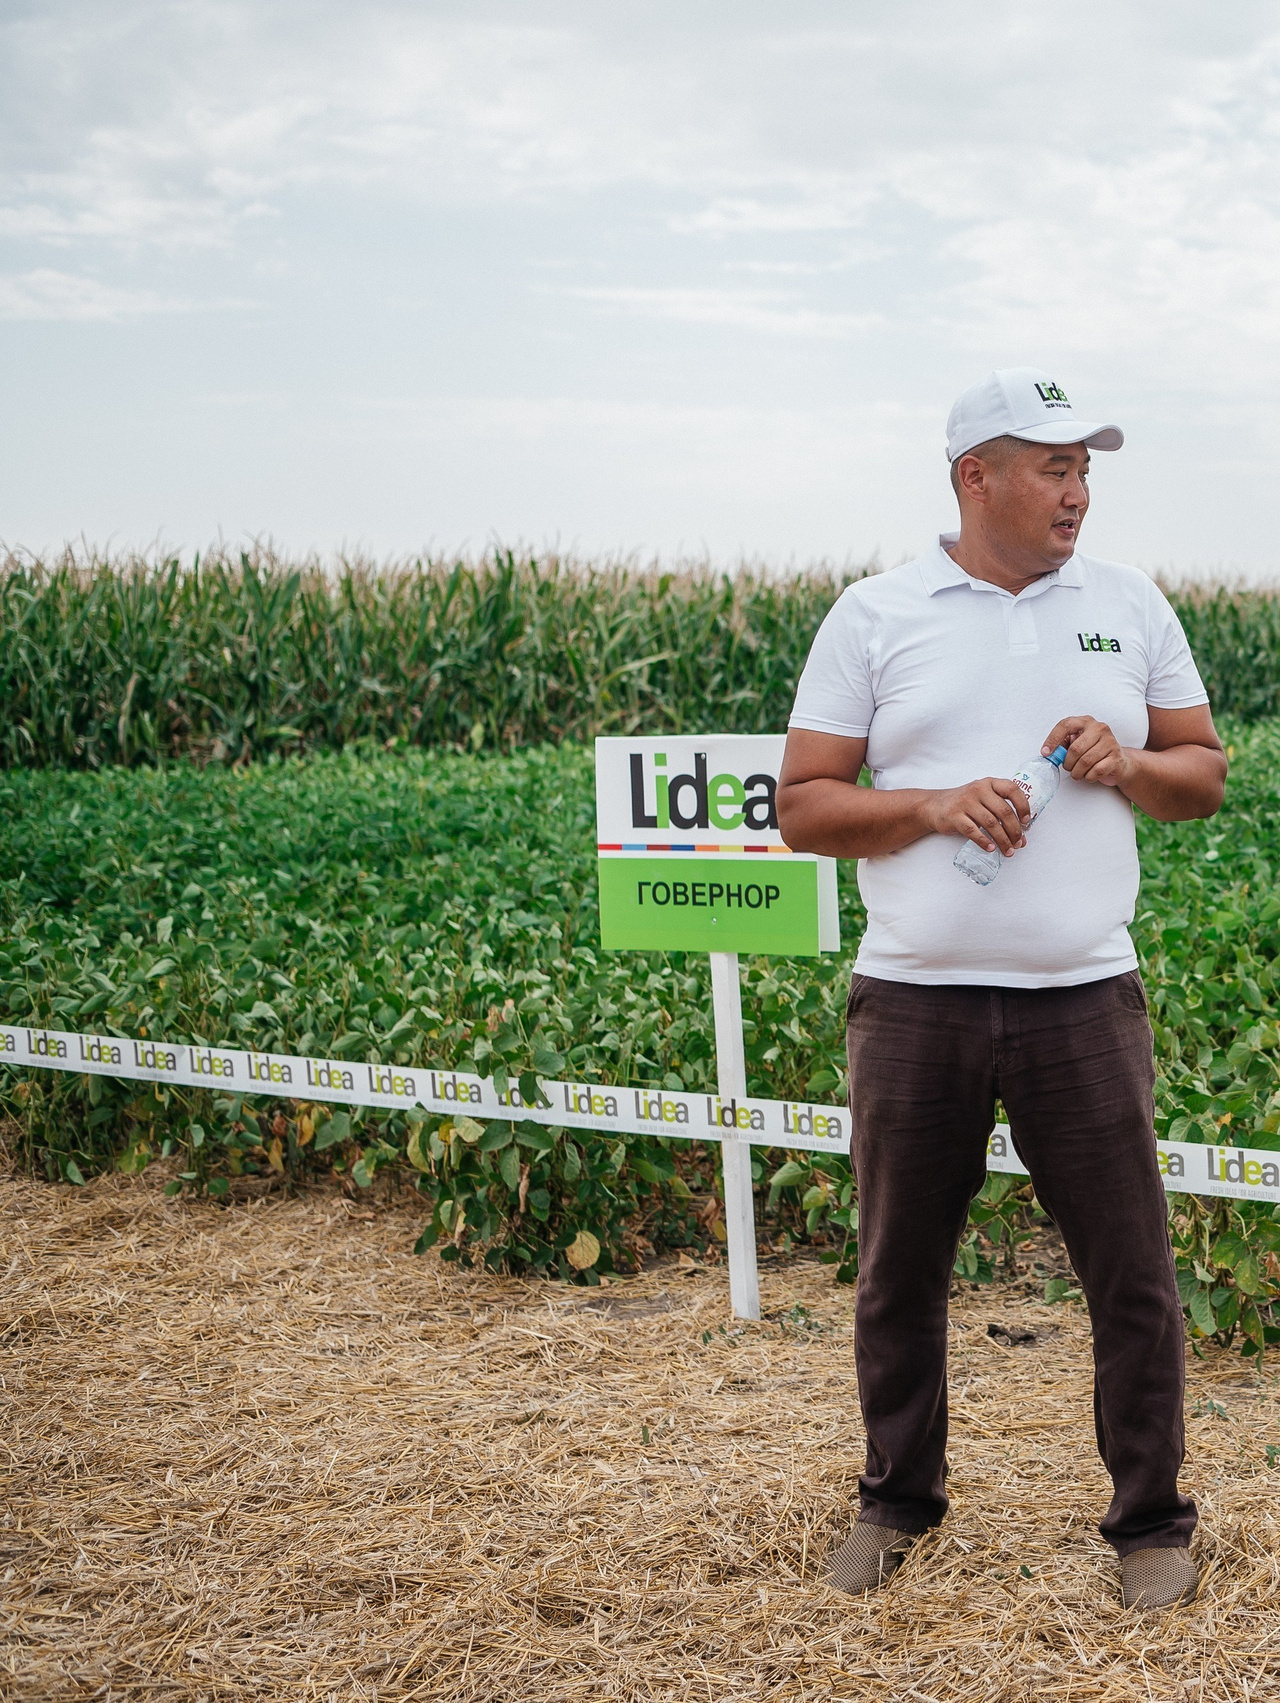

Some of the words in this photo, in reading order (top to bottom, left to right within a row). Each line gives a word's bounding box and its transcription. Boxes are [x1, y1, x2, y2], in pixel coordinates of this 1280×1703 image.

[1077, 633, 1122, 652] Lidea
[629, 752, 780, 830] Lidea
[637, 881, 780, 909] ГОВЕРНОР
[27, 1029, 67, 1058] Lidea
[79, 1035, 121, 1065] Lidea
[133, 1041, 177, 1071] Lidea
[189, 1047, 234, 1077] Lidea
[247, 1053, 293, 1084] Lidea
[306, 1059, 354, 1090] Lidea
[368, 1066, 416, 1097] Lidea
[430, 1072, 482, 1104] Lidea
[564, 1084, 618, 1117] Lidea
[634, 1090, 690, 1124] Lidea
[706, 1096, 765, 1130] Lidea
[783, 1103, 843, 1139] Lidea
[1207, 1148, 1280, 1187] Lidea
